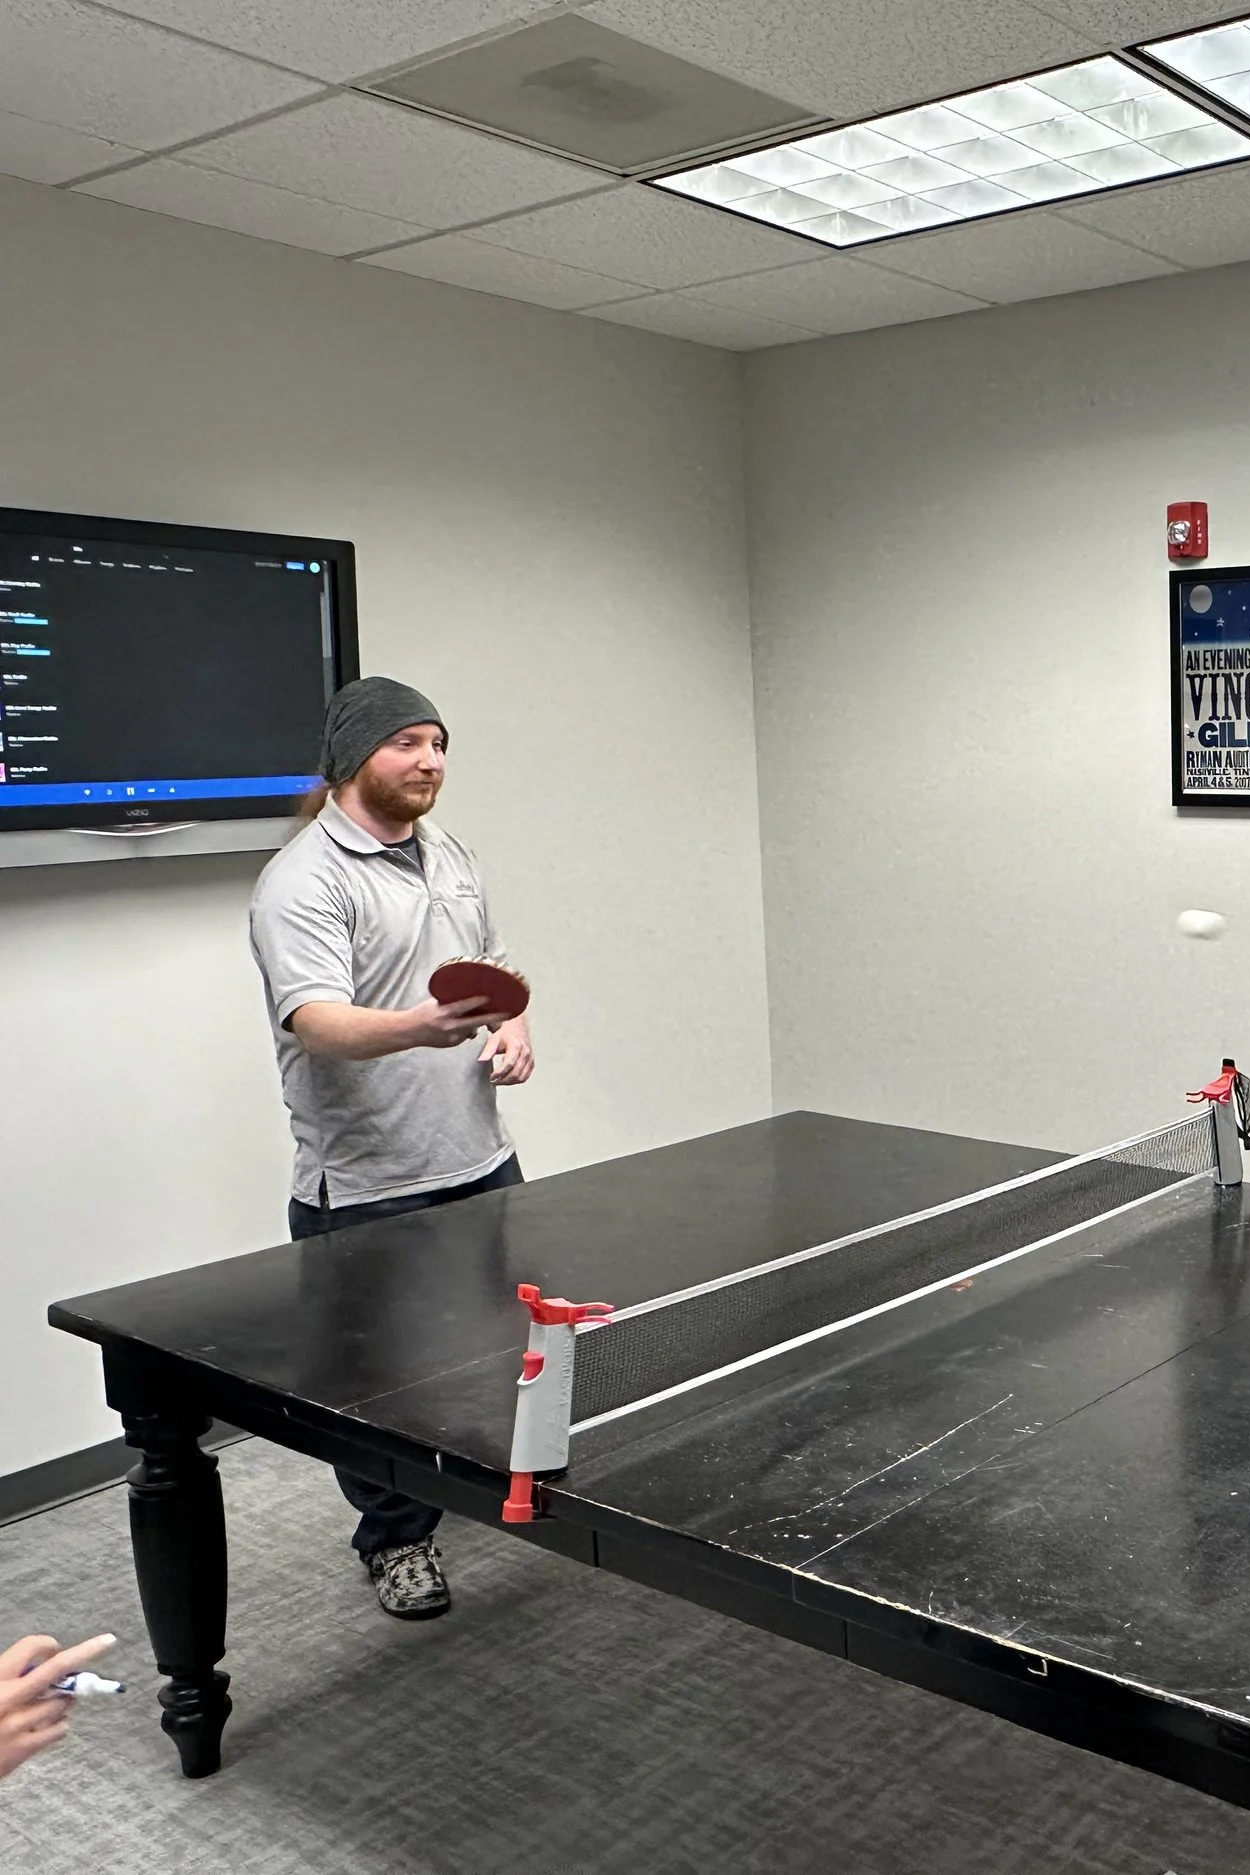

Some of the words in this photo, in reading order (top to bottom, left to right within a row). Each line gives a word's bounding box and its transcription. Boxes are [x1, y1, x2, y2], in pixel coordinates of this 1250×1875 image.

[1186, 750, 1222, 768] RYMAN
[1211, 777, 1217, 787] 4
[1218, 777, 1225, 788] &
